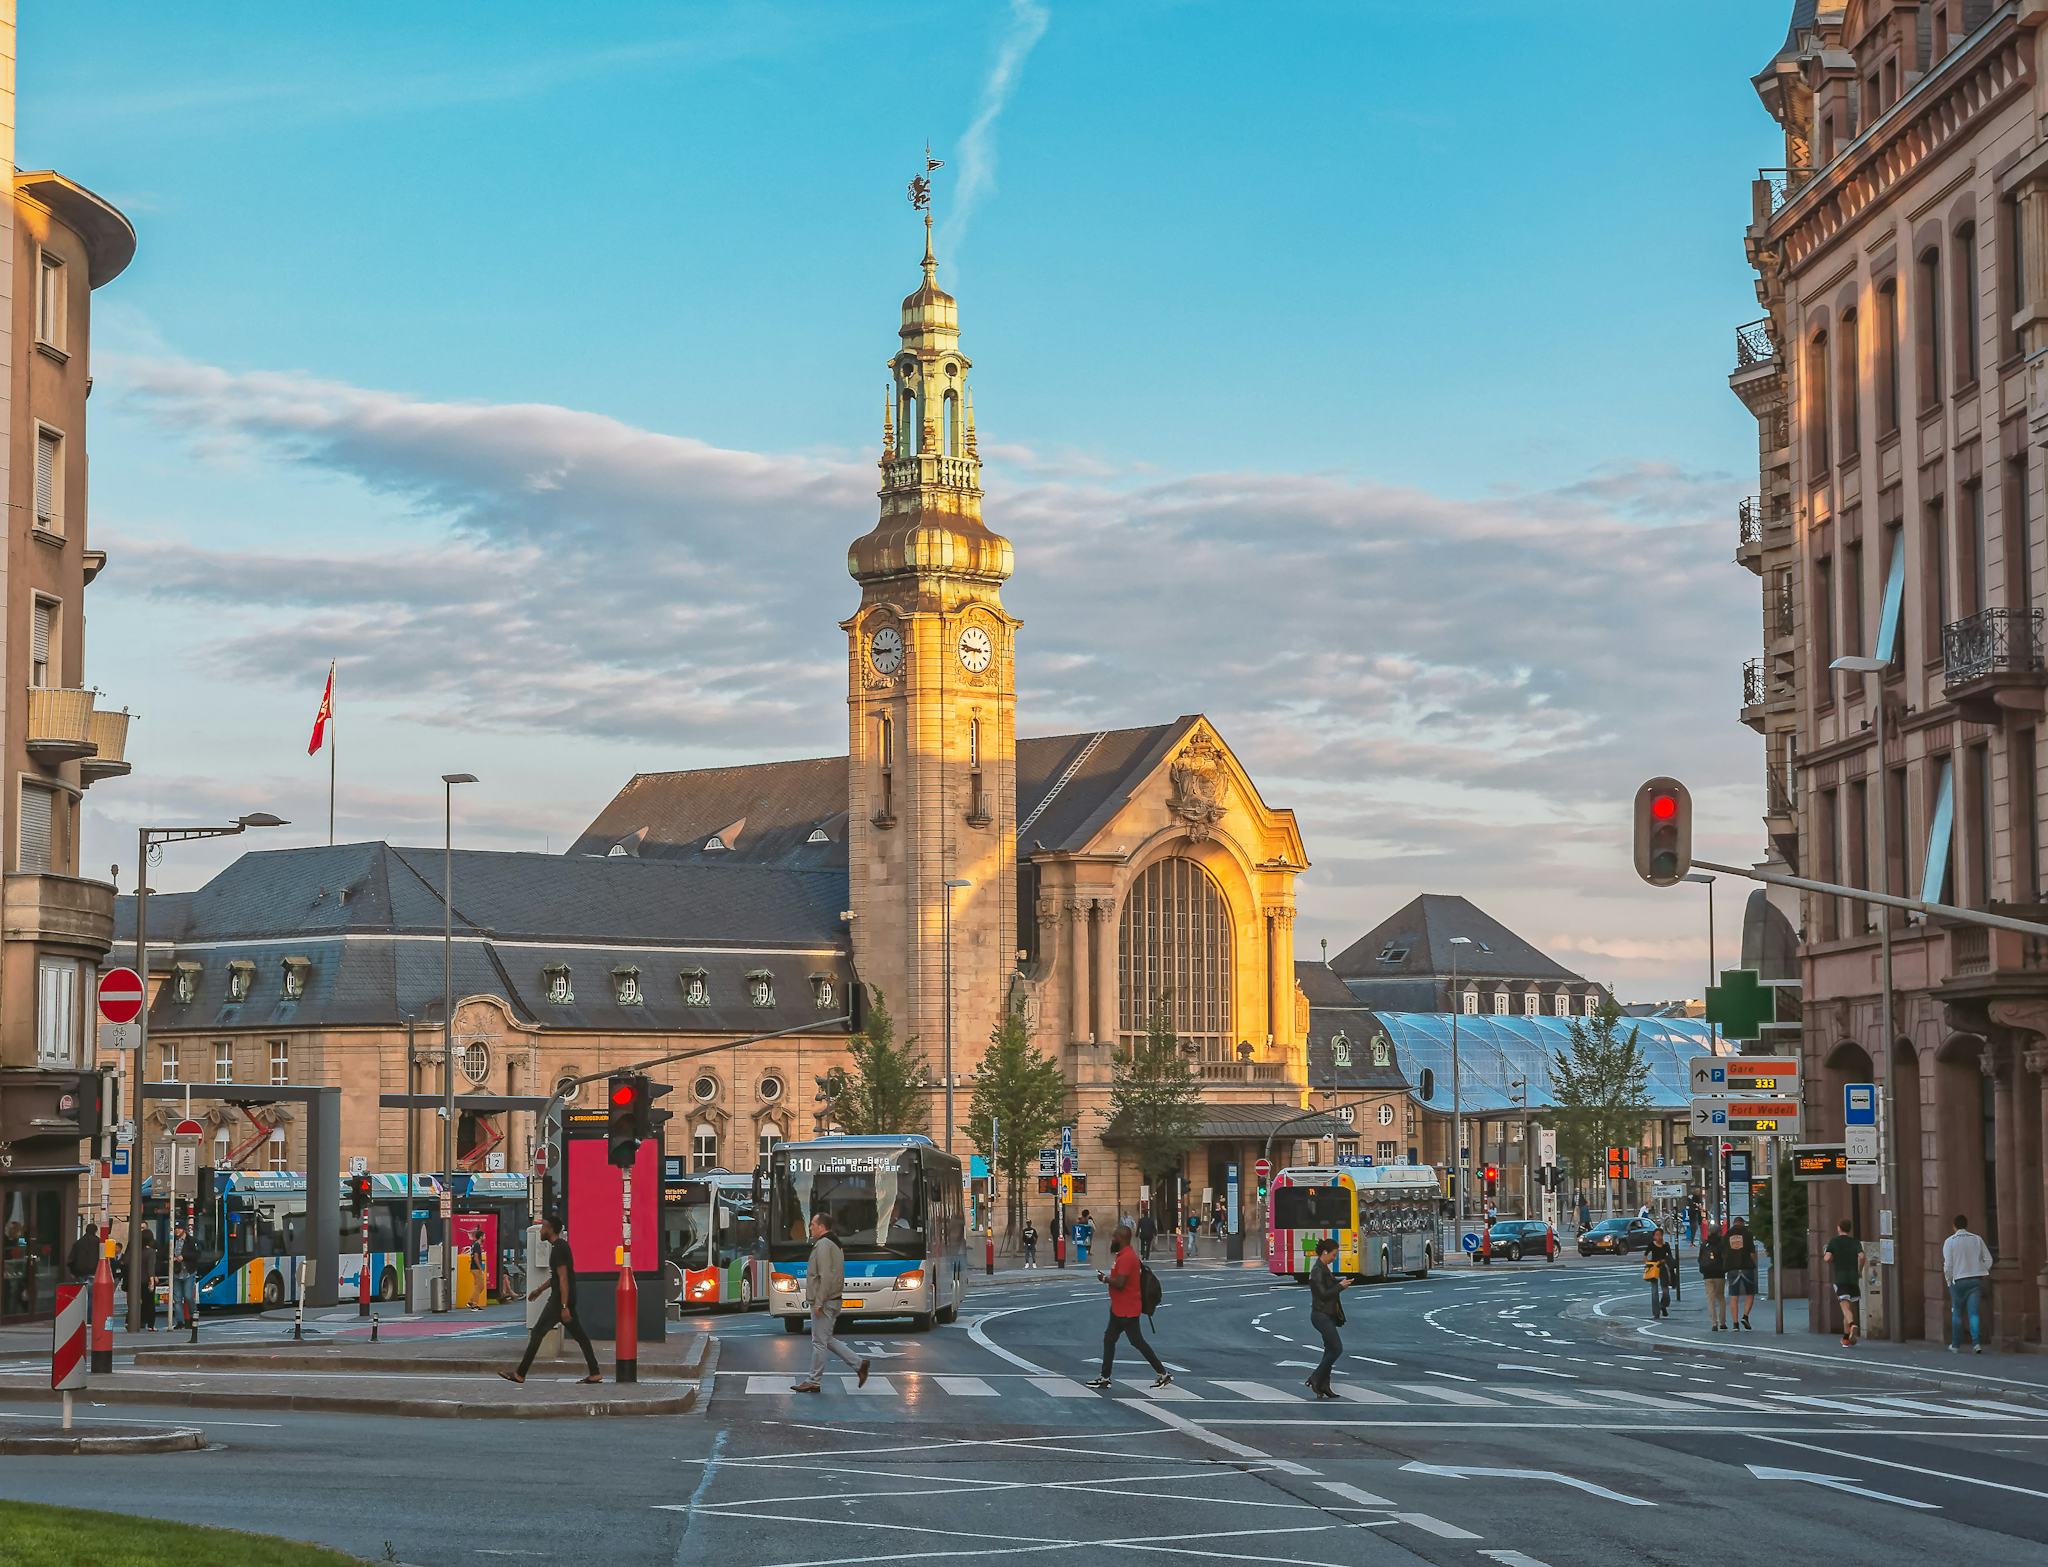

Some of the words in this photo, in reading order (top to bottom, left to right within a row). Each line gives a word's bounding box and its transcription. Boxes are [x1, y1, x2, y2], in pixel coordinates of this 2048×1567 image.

[1730, 1064, 1754, 1073] Gare
[1714, 1071, 1722, 1080] P
[1755, 1079, 1775, 1089] 333
[1731, 1105, 1752, 1114] Fort
[1758, 1105, 1793, 1114] Wedell
[1756, 1120, 1776, 1130] 274
[1852, 1145, 1869, 1154] 101
[357, 1163, 363, 1171] 3
[789, 1158, 812, 1172] 810
[819, 1164, 846, 1173] Usine
[254, 1180, 291, 1188] ELECTRIC
[489, 1181, 519, 1189] ELECTRIC
